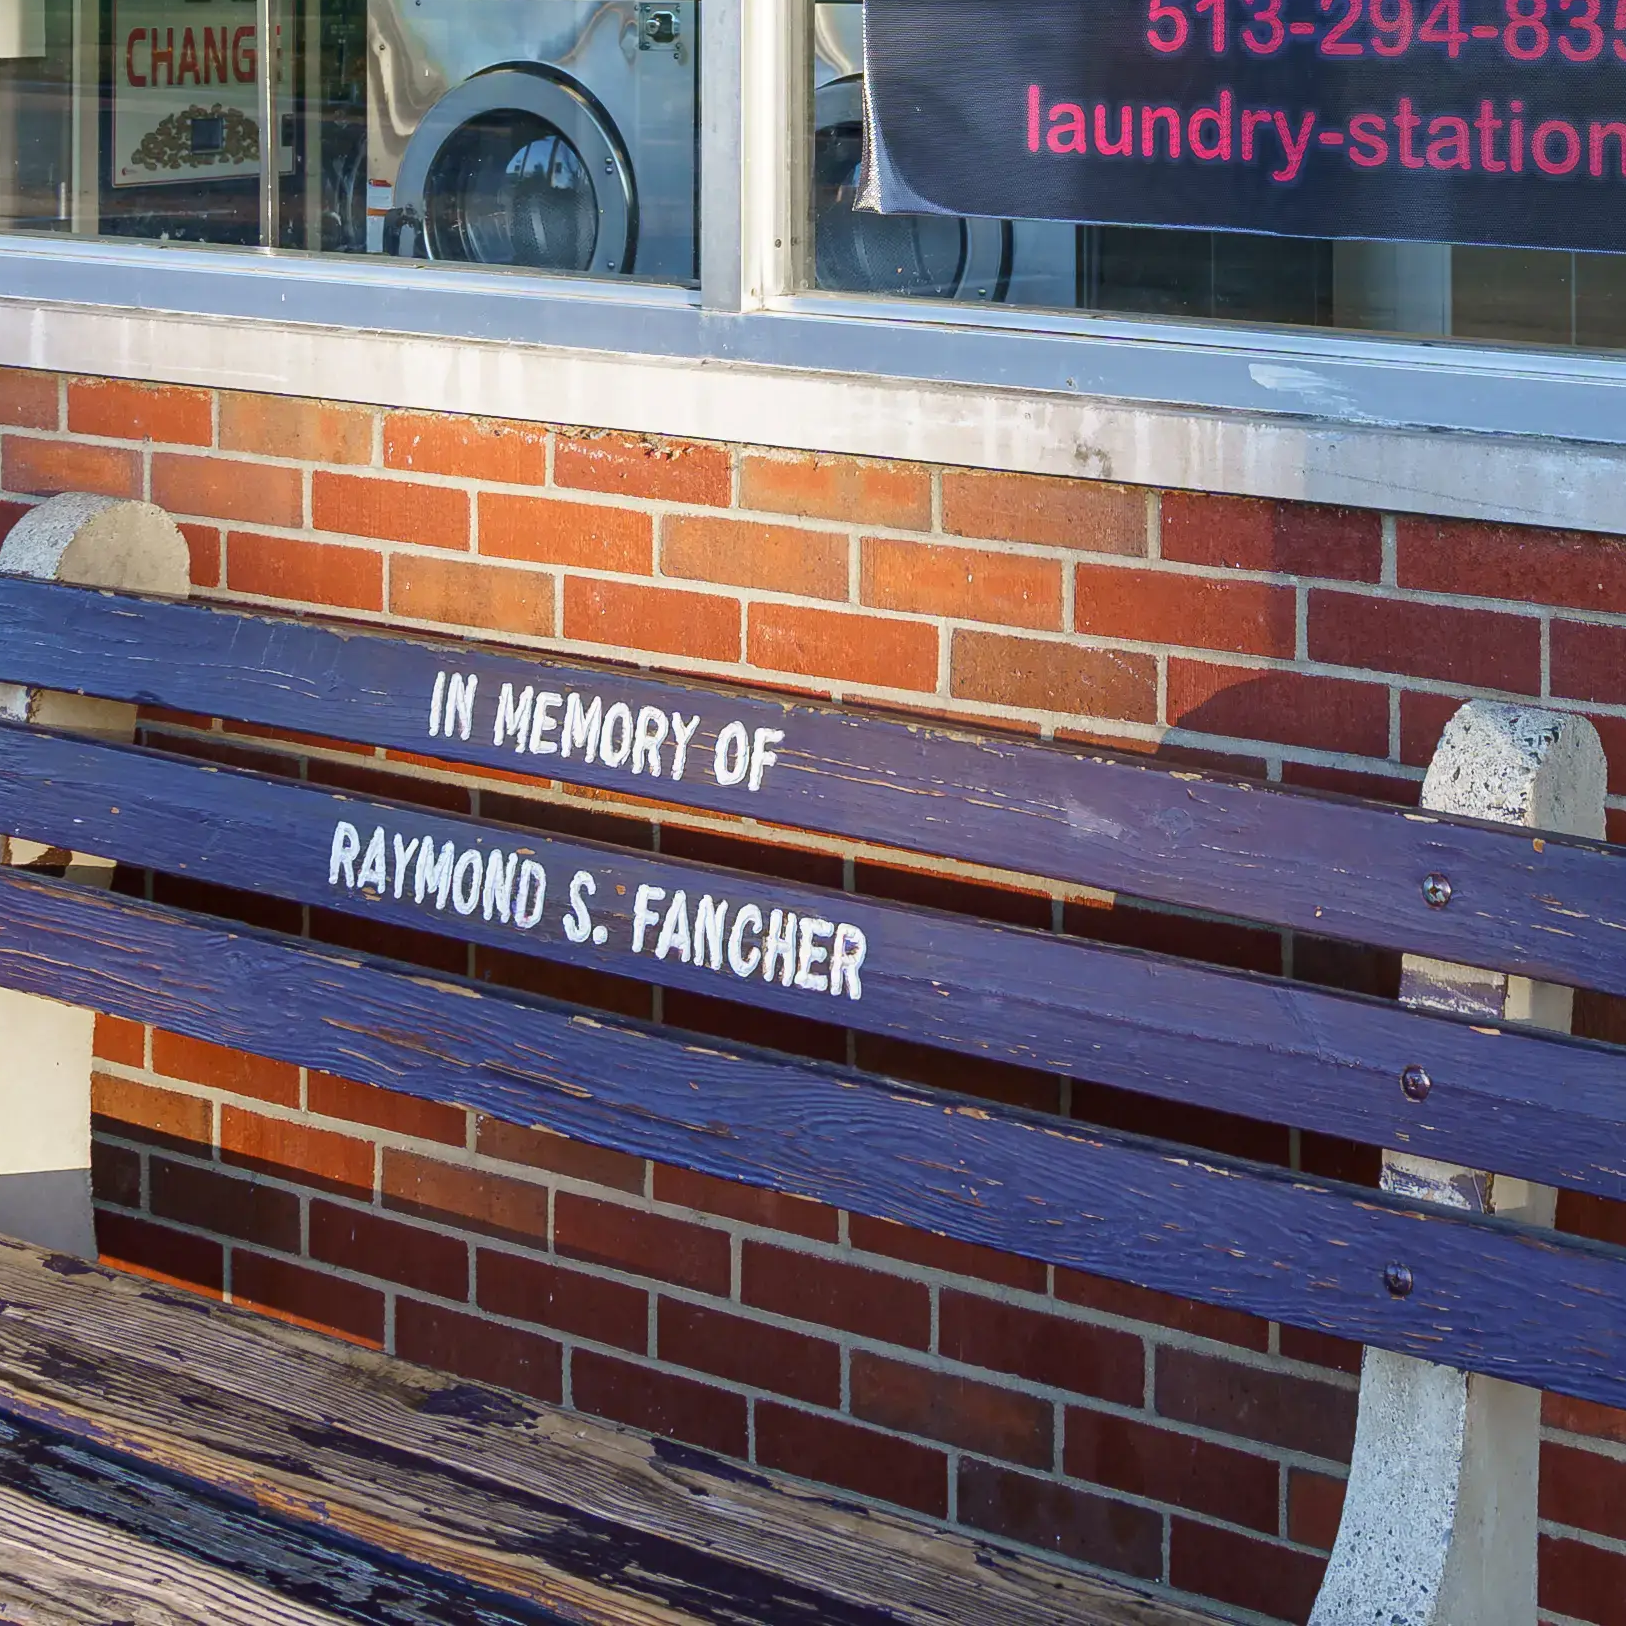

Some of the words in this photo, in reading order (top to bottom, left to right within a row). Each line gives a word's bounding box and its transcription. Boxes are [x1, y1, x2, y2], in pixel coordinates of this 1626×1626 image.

[126, 25, 281, 87] CHANG
[429, 670, 478, 741] IN
[494, 681, 700, 781] MEMORY
[714, 720, 785, 792] OF
[328, 820, 547, 928] RAYMOND
[562, 870, 608, 946] S.
[632, 884, 868, 1001] FANCHER
